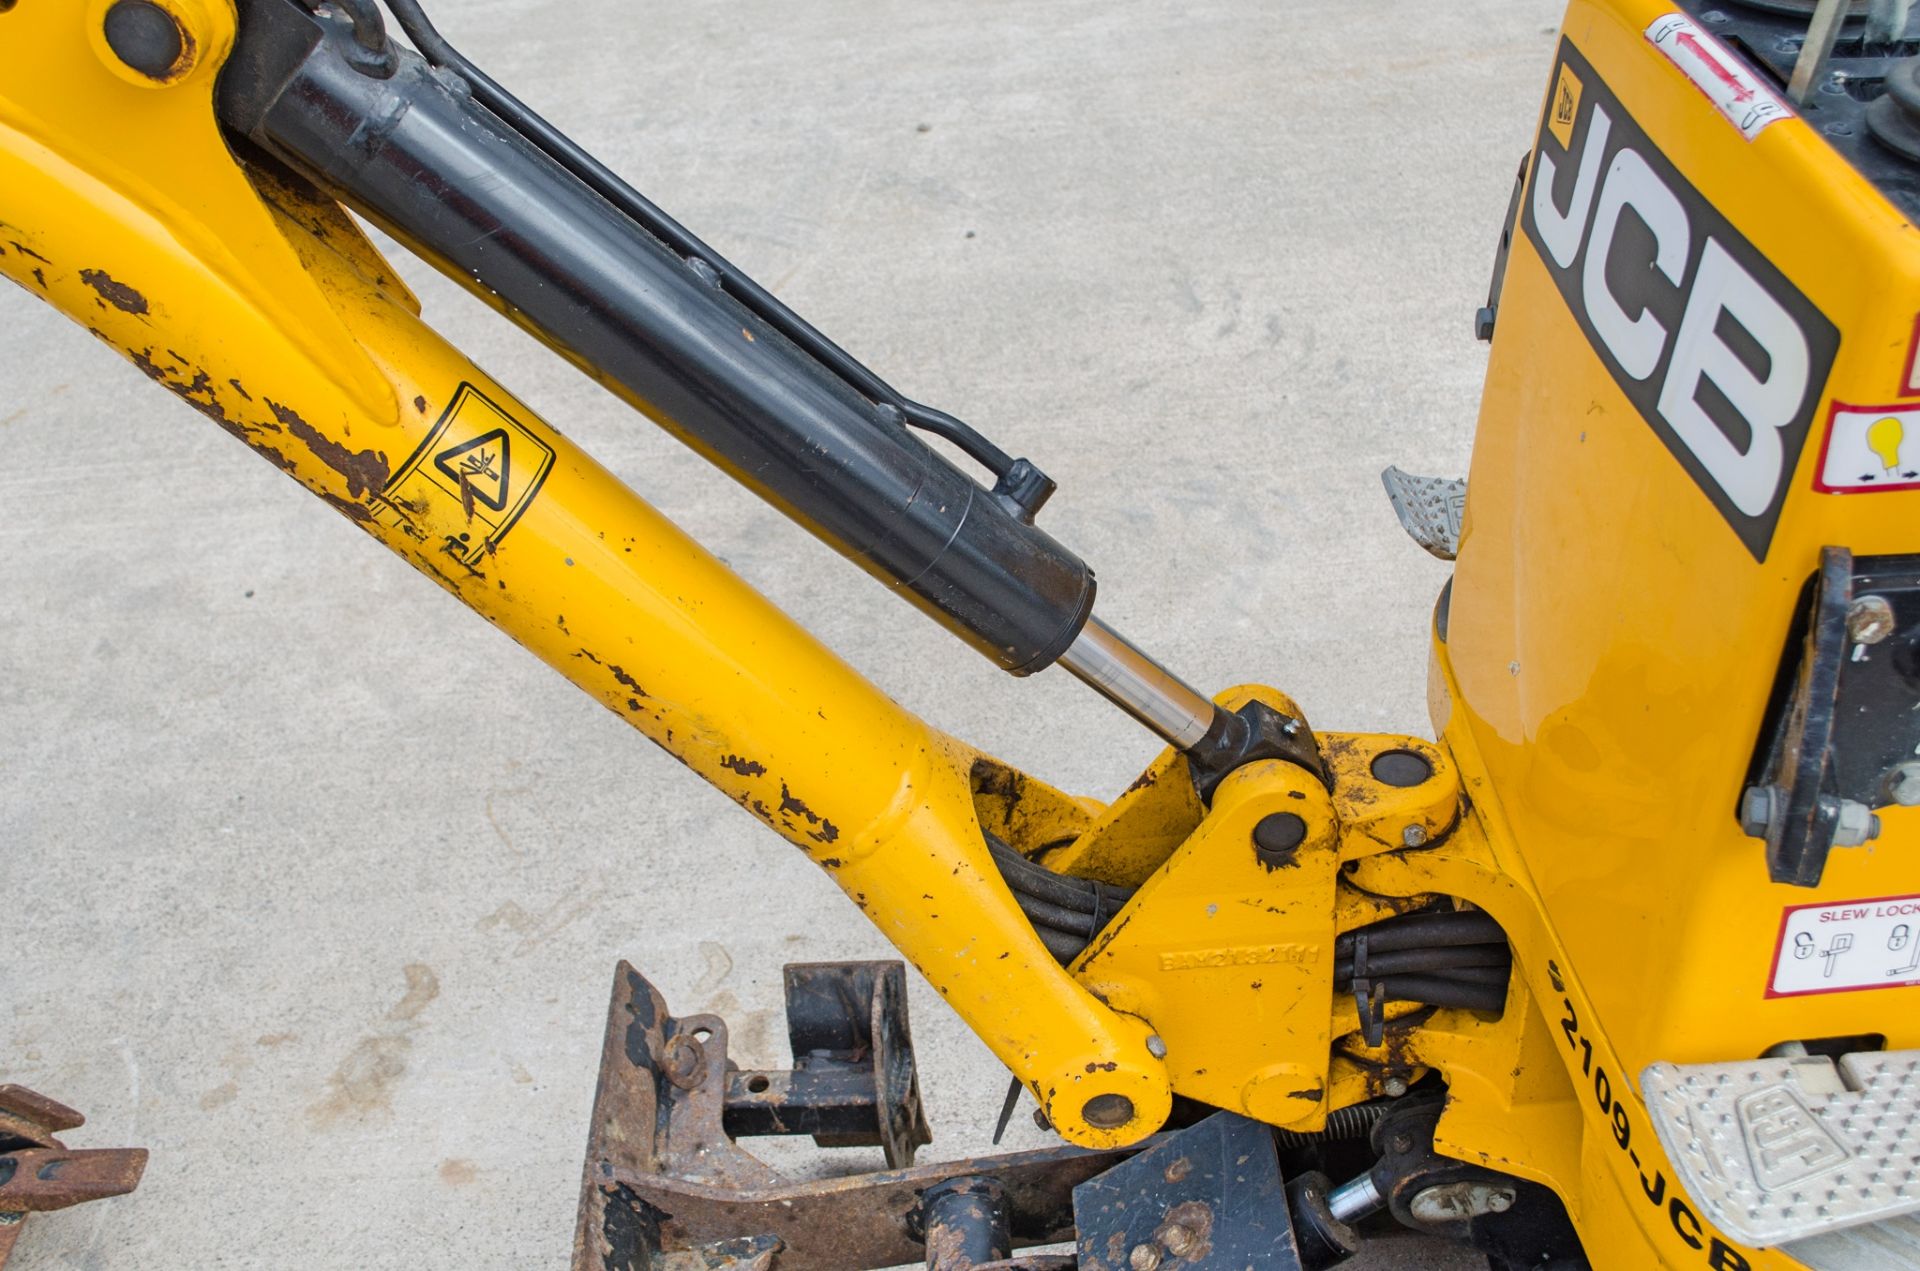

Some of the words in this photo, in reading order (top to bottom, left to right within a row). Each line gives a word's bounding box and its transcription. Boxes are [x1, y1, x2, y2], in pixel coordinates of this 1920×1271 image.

[1533, 103, 1810, 517] JCB
[1819, 908, 1869, 922] SLEW
[1745, 1093, 1838, 1172] JCB
